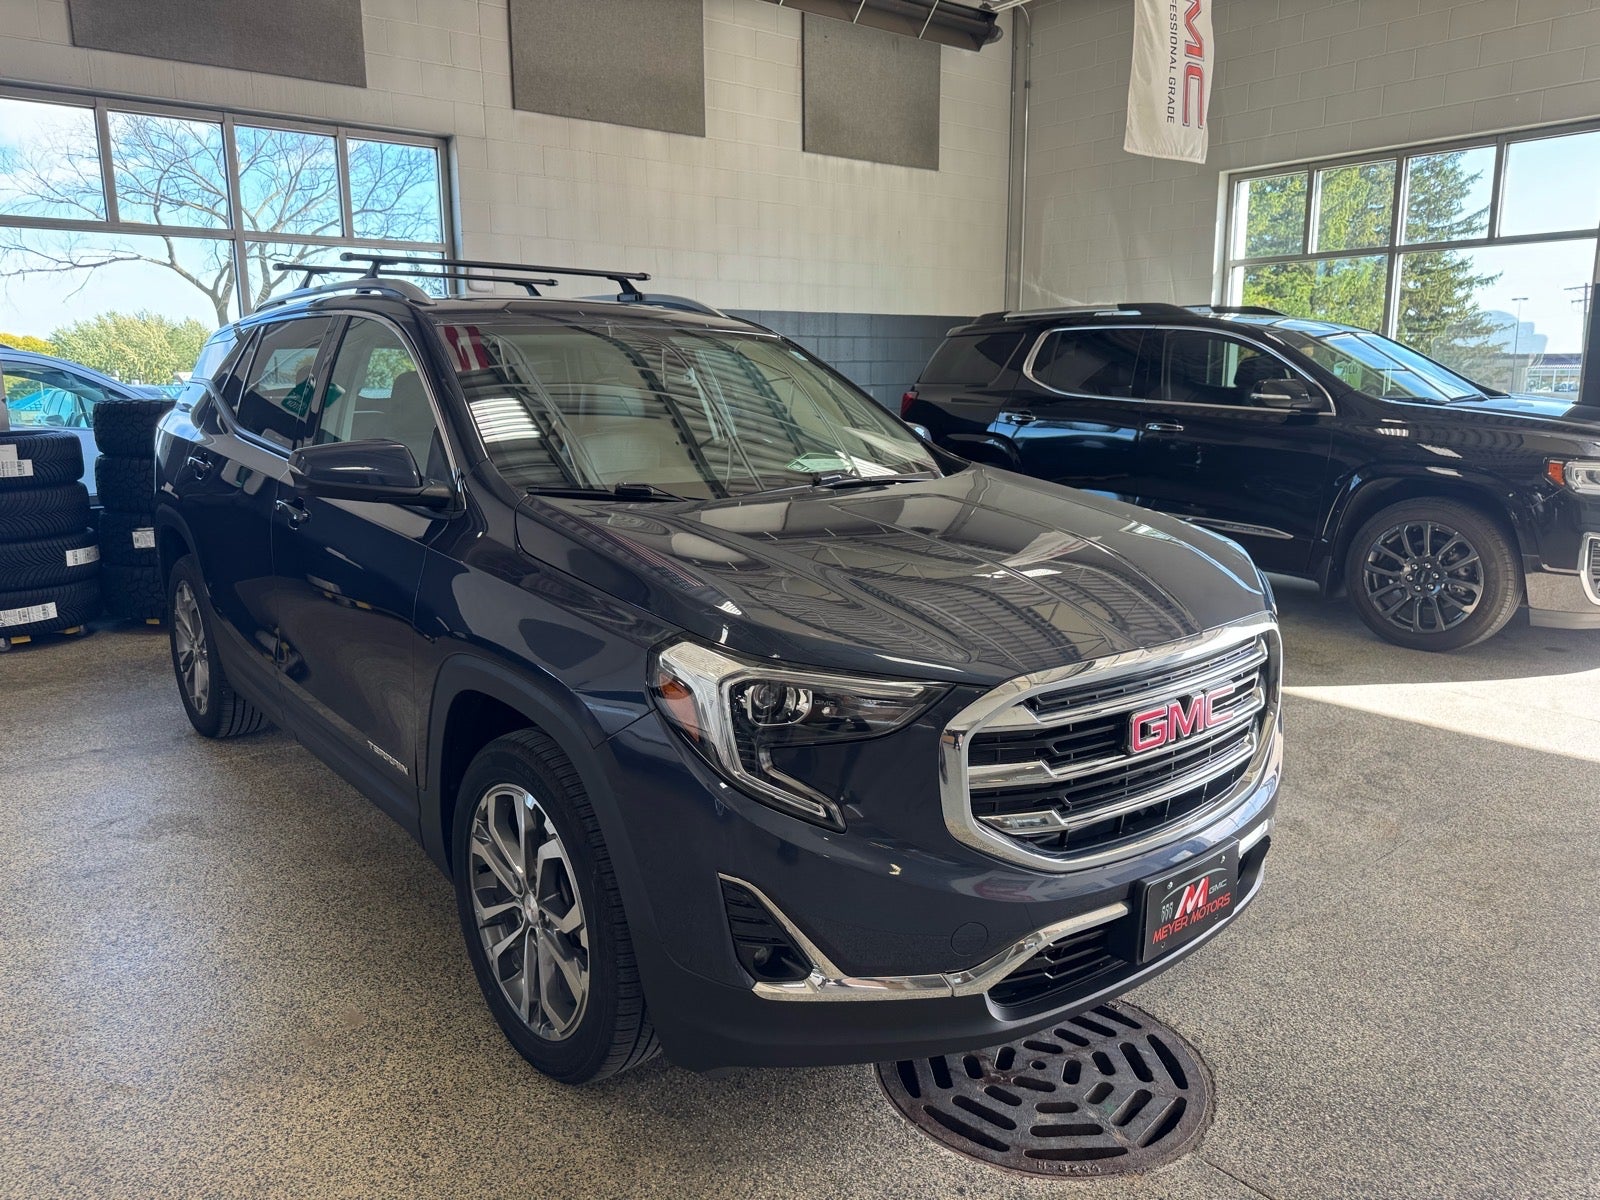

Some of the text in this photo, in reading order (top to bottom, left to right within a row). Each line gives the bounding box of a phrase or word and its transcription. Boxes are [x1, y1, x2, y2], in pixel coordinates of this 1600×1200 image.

[1166, 77, 1177, 124] GRADE
[814, 699, 836, 707] GMC
[1131, 686, 1236, 753] GMC
[1208, 878, 1228, 895] GMC
[1152, 892, 1231, 945] MEYER MOTORS
